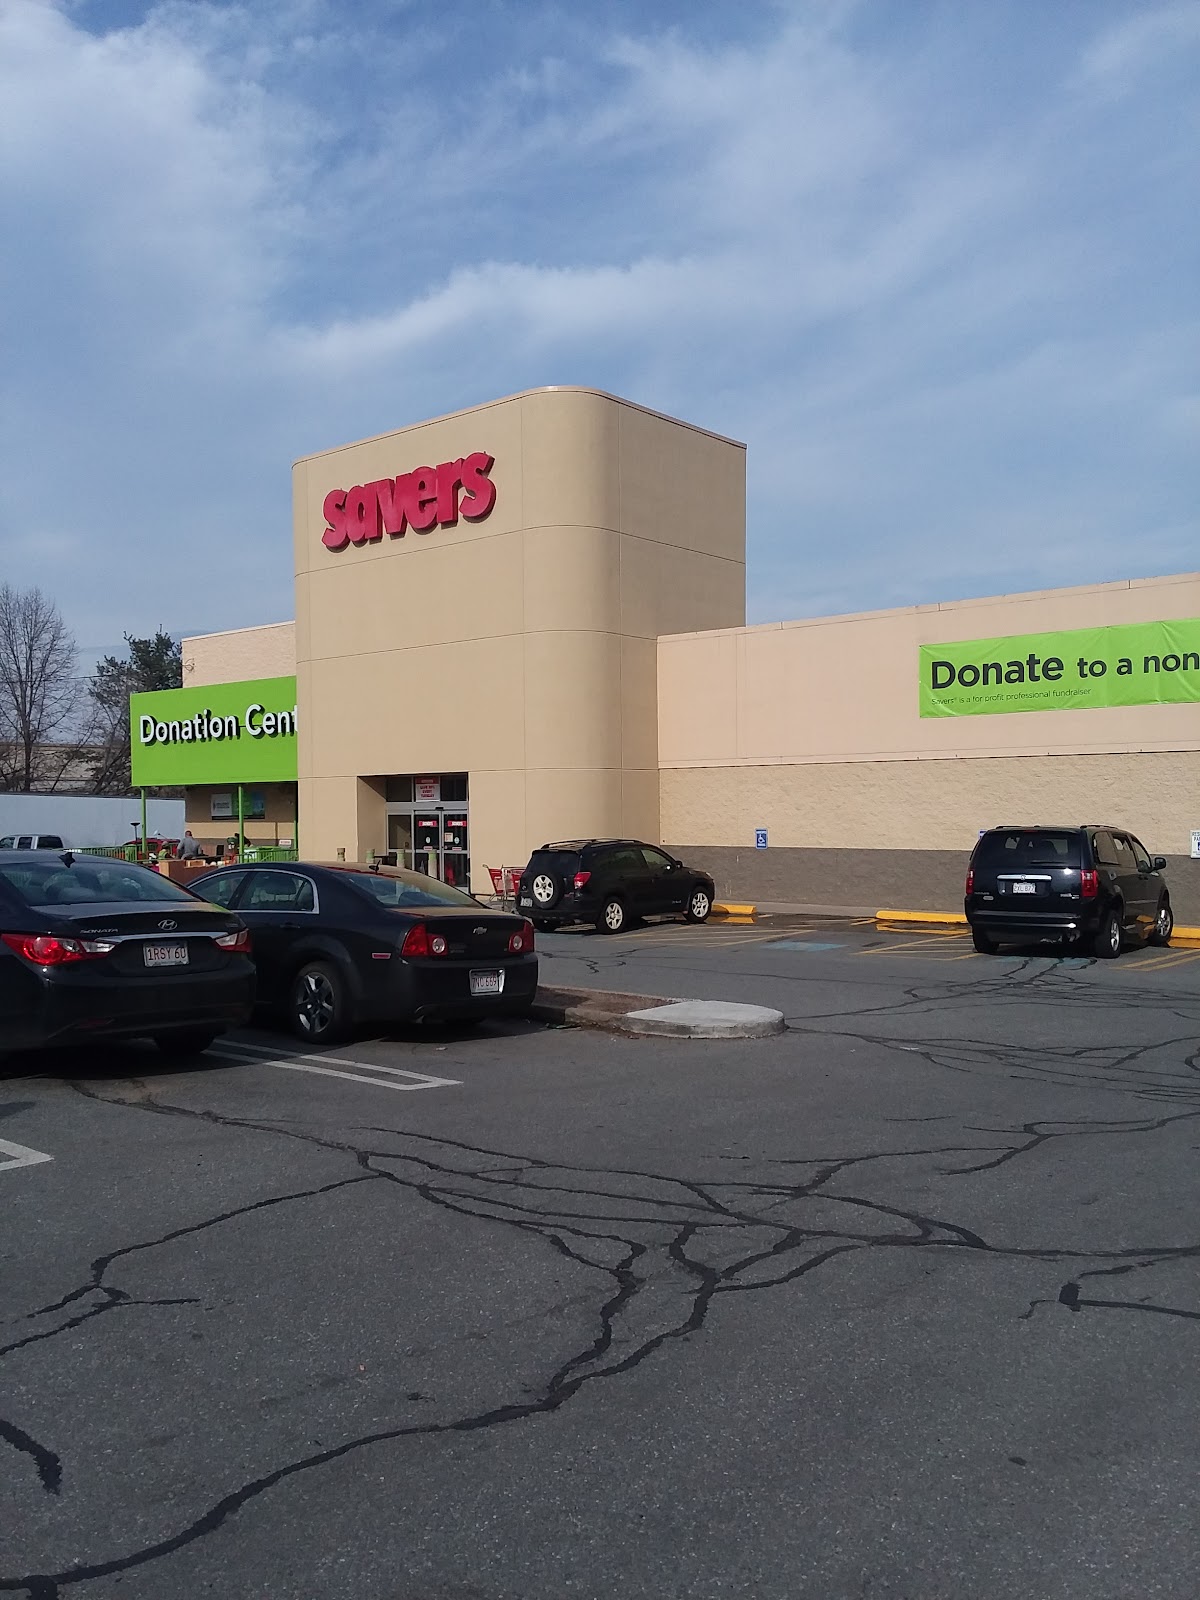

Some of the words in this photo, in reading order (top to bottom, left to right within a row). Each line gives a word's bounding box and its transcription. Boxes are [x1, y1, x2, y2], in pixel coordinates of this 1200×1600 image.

[321, 451, 497, 550] savers
[931, 653, 1064, 689] Donate
[1077, 657, 1107, 678] to
[1116, 658, 1133, 676] a
[1143, 652, 1200, 674] non
[985, 693, 1004, 702] profit
[1006, 690, 1051, 700] professional
[1052, 687, 1092, 697] fundraiser
[139, 708, 238, 744] Donation
[147, 947, 171, 960] 1RSY
[174, 946, 186, 959] 60
